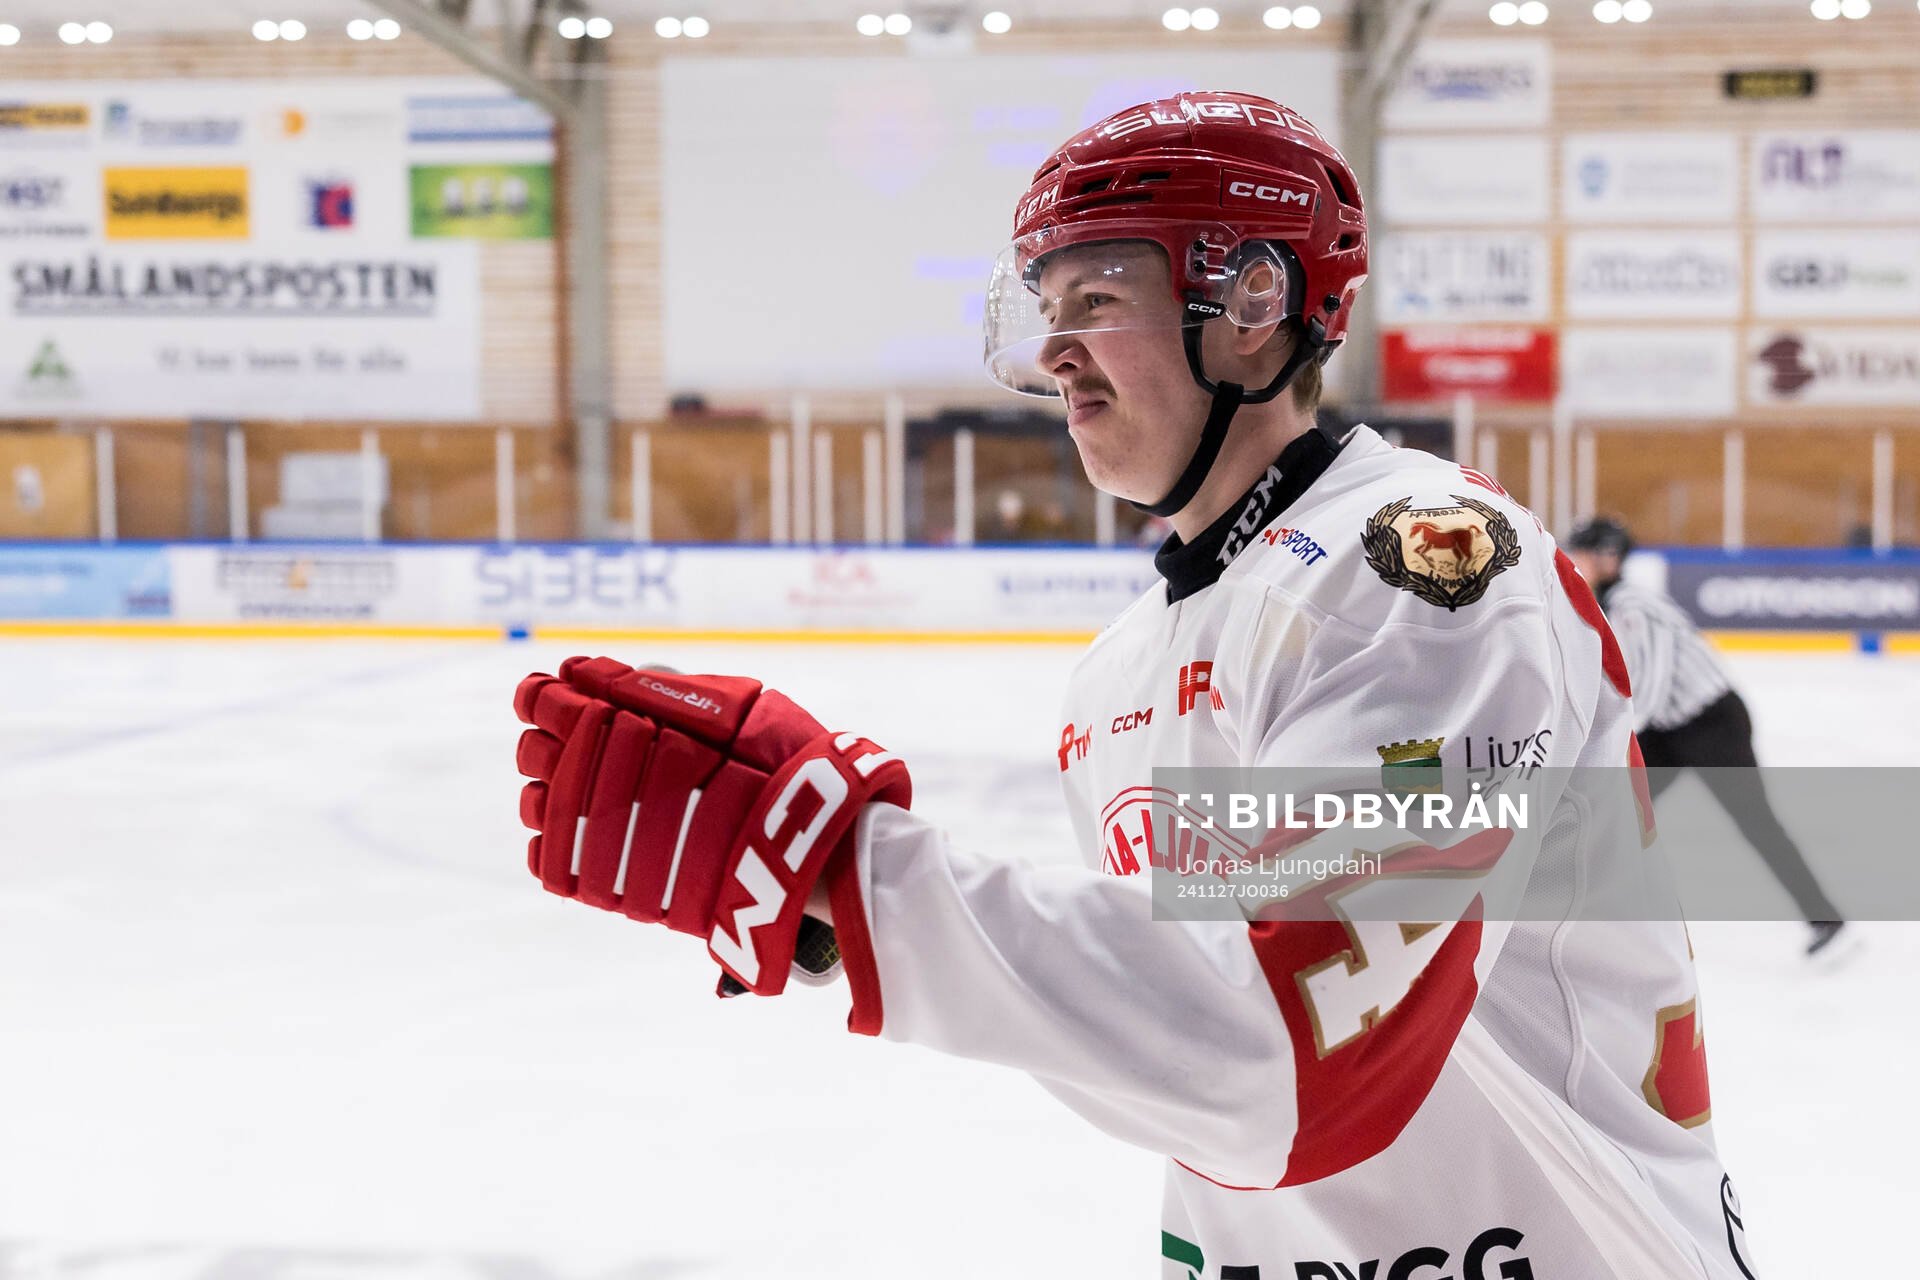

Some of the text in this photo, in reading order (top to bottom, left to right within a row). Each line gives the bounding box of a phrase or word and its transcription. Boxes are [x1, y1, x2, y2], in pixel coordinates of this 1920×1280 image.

[1229, 181, 1309, 207] CCM
[13, 257, 437, 301] SMÅLANDSPOSTEN
[1188, 303, 1221, 315] CCM
[1216, 464, 1285, 565] CCM
[1111, 706, 1154, 735] CCM
[709, 731, 905, 987] CCM
